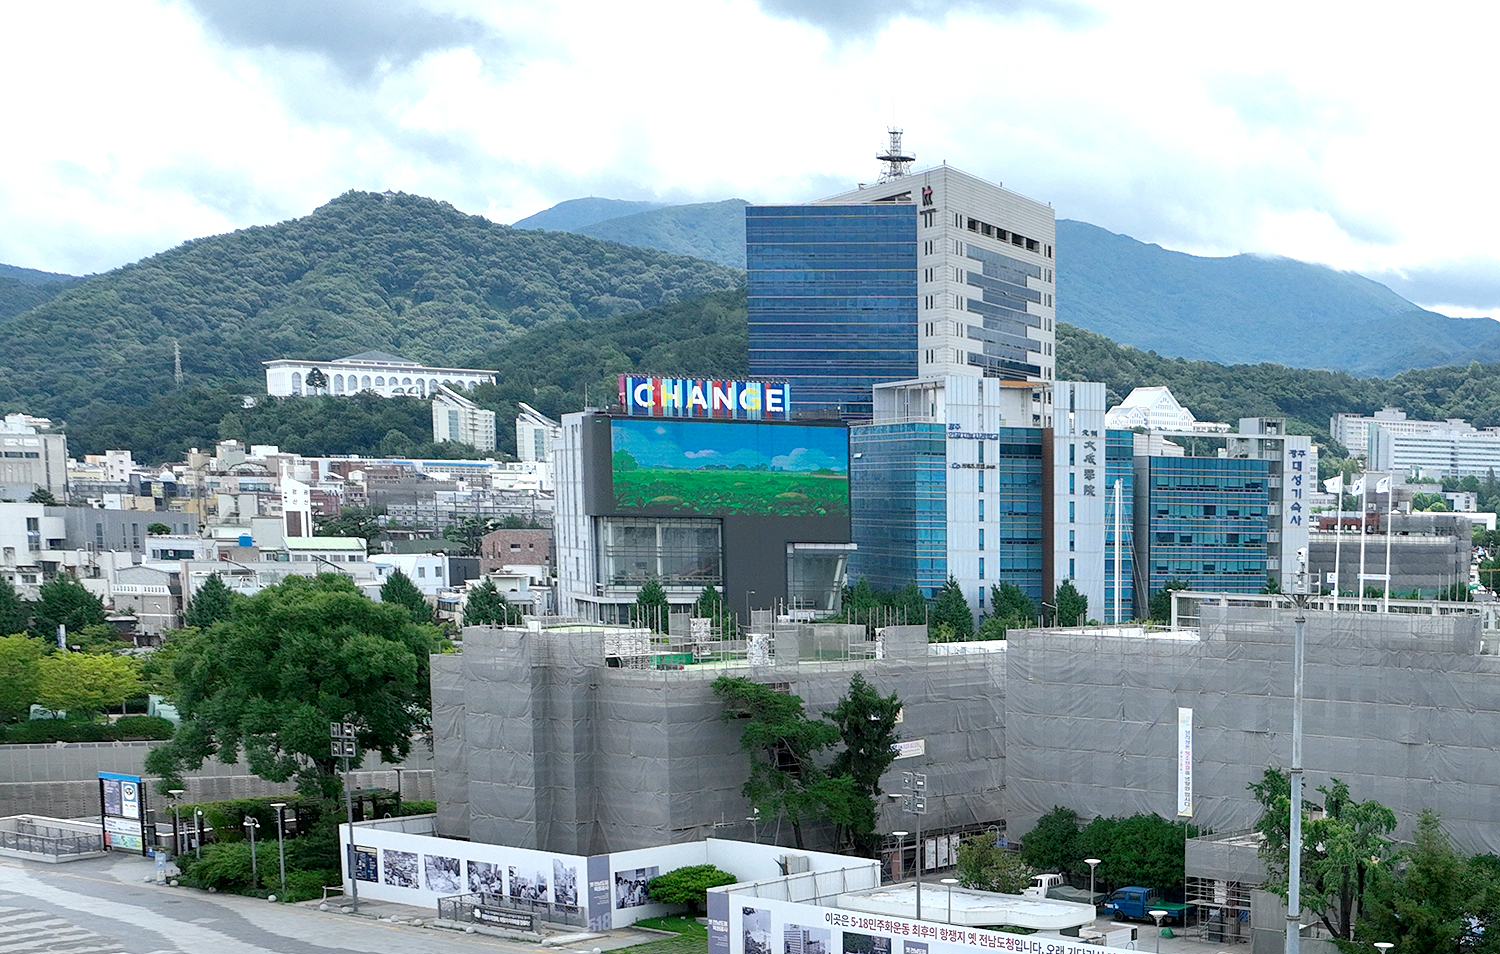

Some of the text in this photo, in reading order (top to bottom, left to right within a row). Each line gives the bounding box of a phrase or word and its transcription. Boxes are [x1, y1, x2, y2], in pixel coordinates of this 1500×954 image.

[634, 383, 783, 412] CHANGE
[1288, 449, 1306, 458] 광주
[1290, 461, 1302, 526] 대성기숙사
[825, 912, 849, 927] 이곳은
[912, 924, 938, 939] 최후의
[940, 928, 966, 944] 항쟁지
[968, 932, 977, 945] 옛
[979, 934, 1044, 954] 전남도청입니다.
